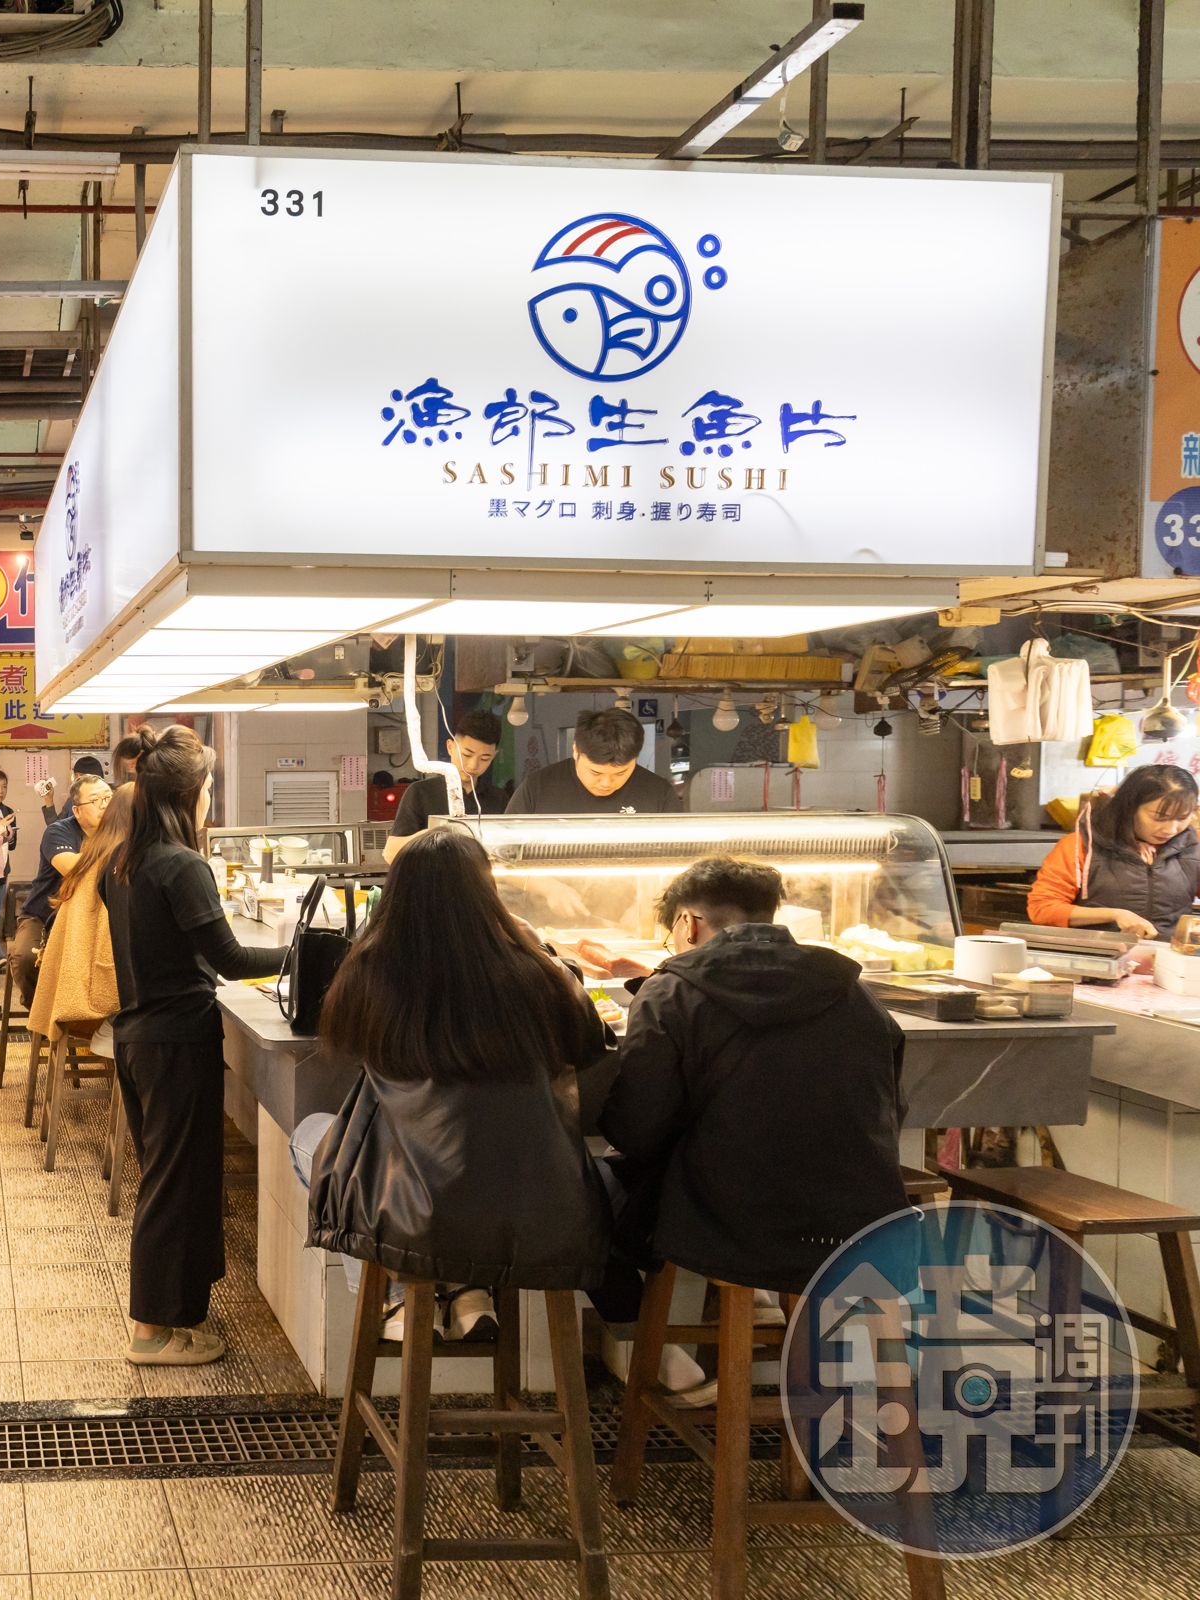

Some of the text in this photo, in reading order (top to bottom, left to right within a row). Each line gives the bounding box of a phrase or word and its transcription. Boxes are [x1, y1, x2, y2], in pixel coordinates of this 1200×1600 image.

[260, 188, 323, 217] 331
[378, 377, 857, 491] 漁郎生魚片
[442, 461, 789, 490] SASHIMI SUSHI
